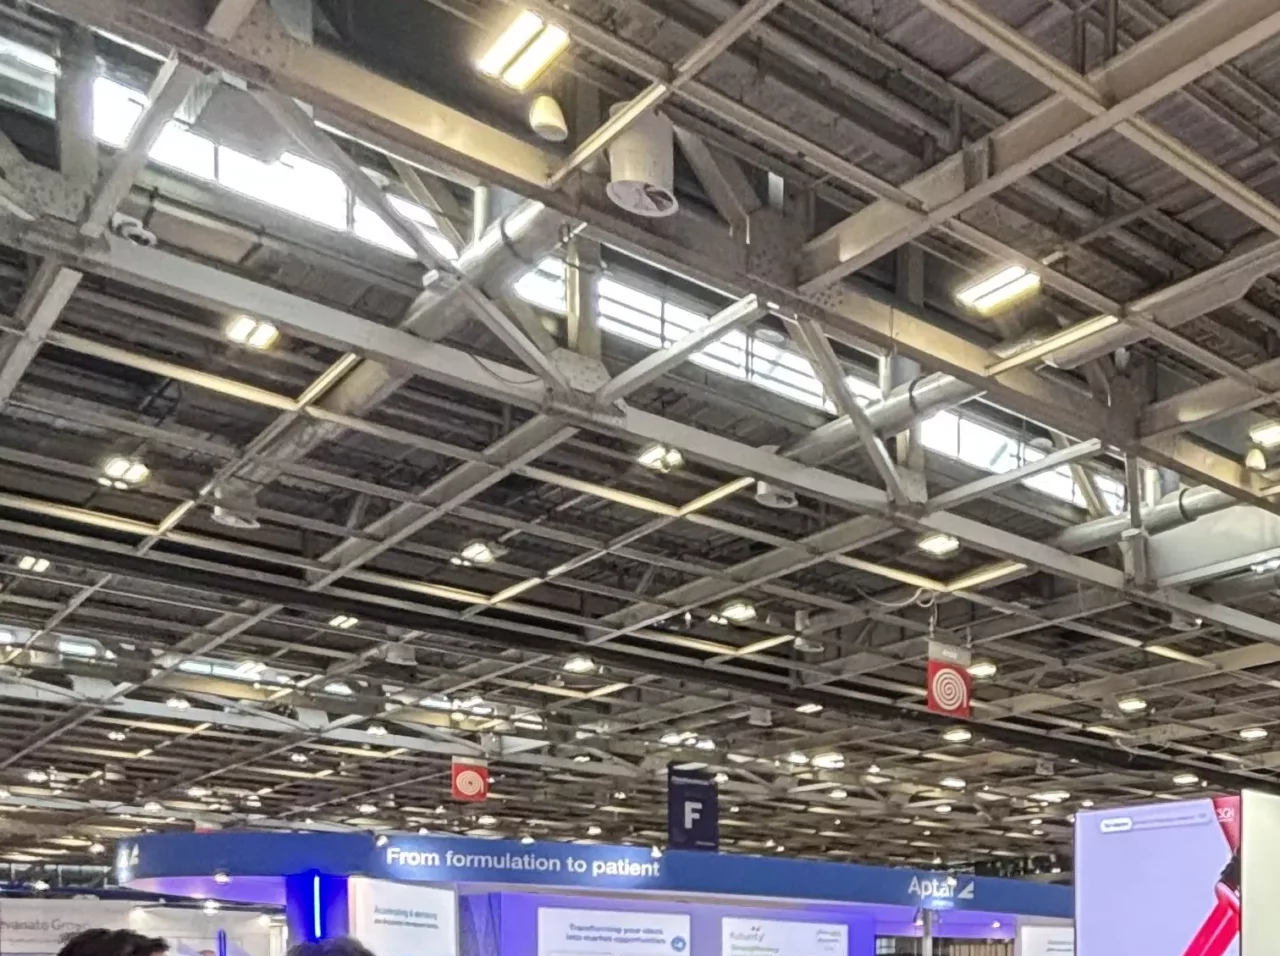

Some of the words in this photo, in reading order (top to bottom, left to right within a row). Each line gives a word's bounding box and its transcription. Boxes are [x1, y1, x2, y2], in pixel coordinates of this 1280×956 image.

[684, 801, 703, 829] F
[386, 848, 440, 867] From
[445, 850, 561, 872] formulation
[567, 857, 587, 873] to
[592, 858, 660, 878] patient
